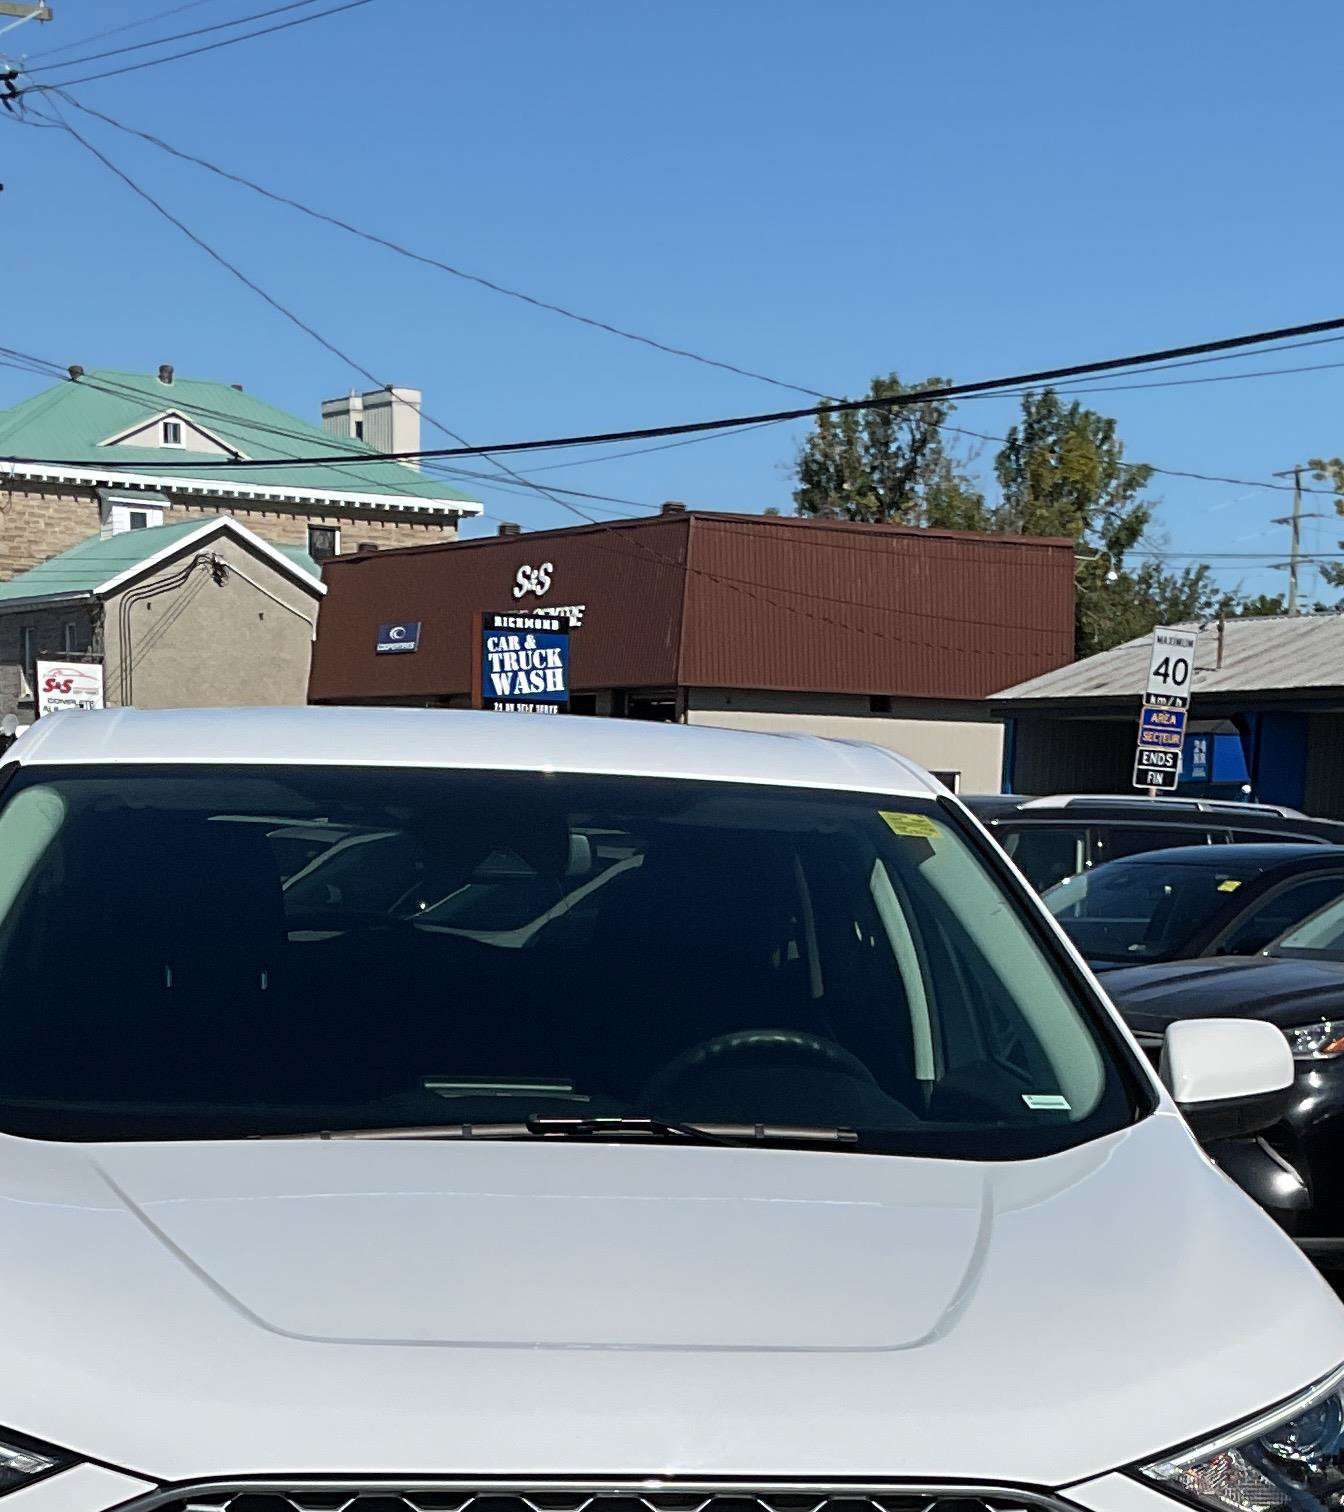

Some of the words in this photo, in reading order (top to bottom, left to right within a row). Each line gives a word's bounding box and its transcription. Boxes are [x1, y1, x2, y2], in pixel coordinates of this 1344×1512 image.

[513, 563, 554, 598] S&S
[494, 616, 559, 631] RICHMOND
[487, 636, 520, 652] CAR
[524, 634, 537, 650] &
[488, 648, 563, 673] TRUCK
[1153, 656, 1188, 686] 40
[490, 668, 565, 696] WASH
[1151, 712, 1176, 724] AREA
[1142, 731, 1181, 744] SECTEUR
[1142, 751, 1174, 766] ENDS
[1147, 771, 1164, 785] FIN
